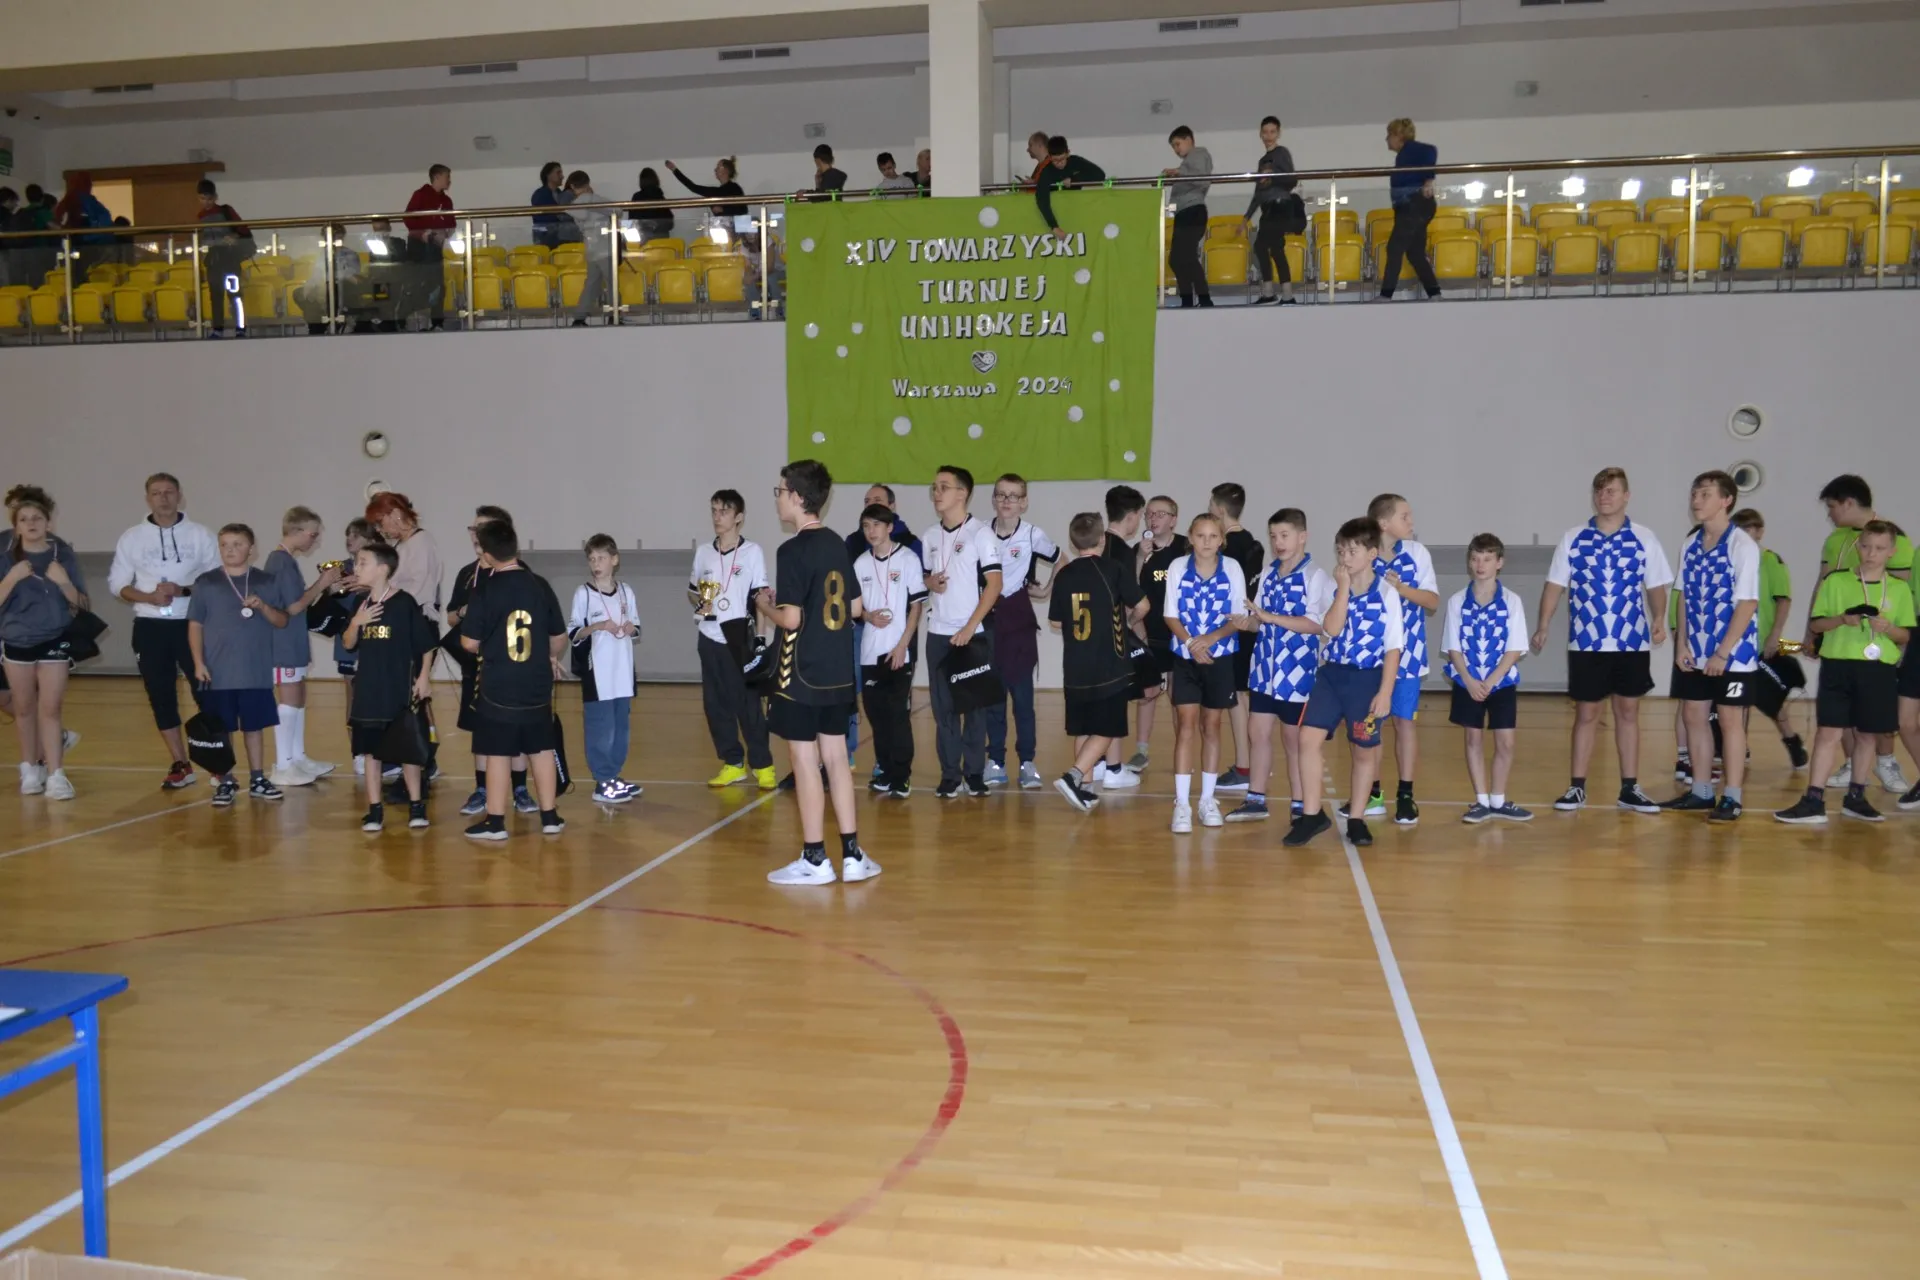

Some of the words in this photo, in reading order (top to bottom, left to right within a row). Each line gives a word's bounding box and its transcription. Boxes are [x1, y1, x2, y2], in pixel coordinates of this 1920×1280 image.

[845, 237, 897, 266] XIV
[906, 231, 1087, 263] TOWARZYSKI
[918, 274, 1047, 304] TURNIEJ
[901, 310, 1068, 340] UNIHOKEJA
[891, 377, 997, 398] Warszawa
[1017, 375, 1073, 396] 2024
[1153, 570, 1168, 582] SPS
[823, 570, 846, 631] 8
[1071, 592, 1092, 641] 5
[506, 609, 533, 662] 6
